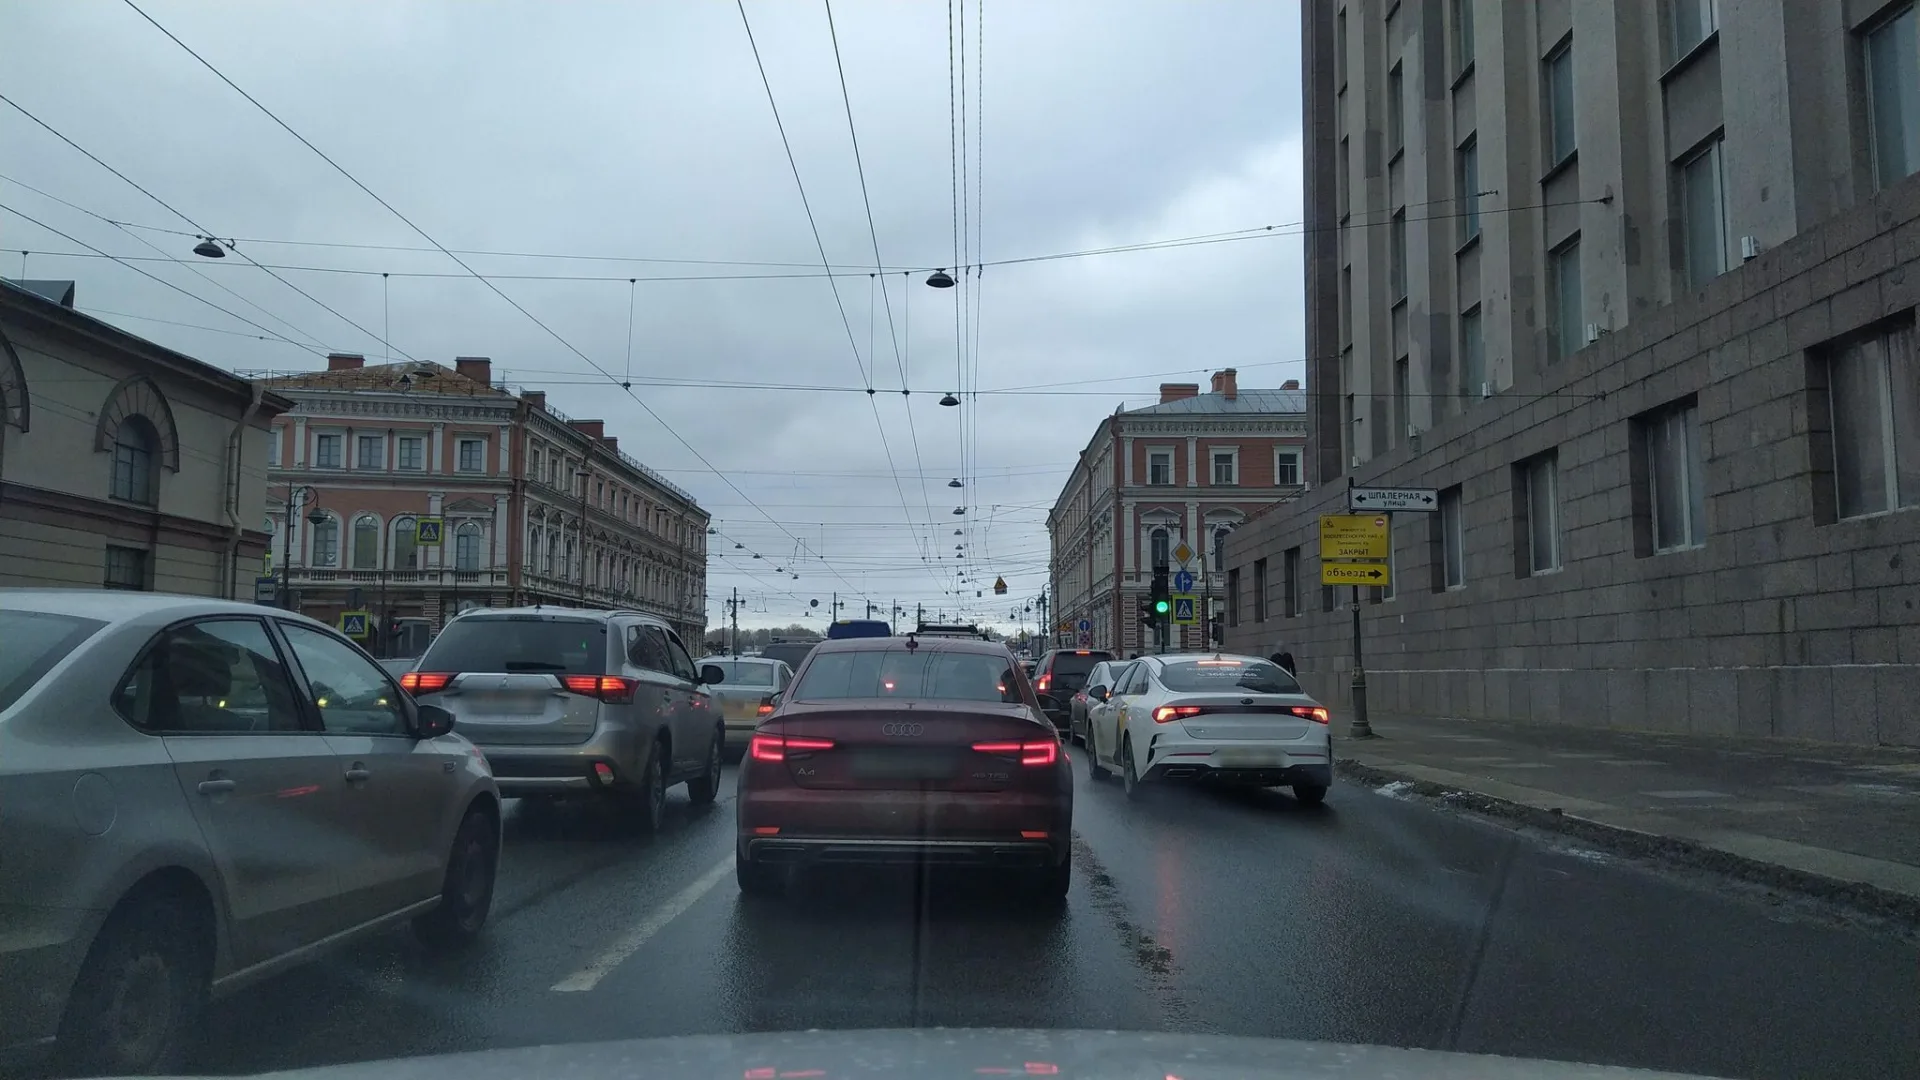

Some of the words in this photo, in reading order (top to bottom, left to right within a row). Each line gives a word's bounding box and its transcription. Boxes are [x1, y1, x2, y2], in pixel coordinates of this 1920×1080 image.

[1368, 491, 1421, 500] ШПАЛЕРНАЯ
[1383, 500, 1406, 508] улица
[1338, 548, 1369, 556] ЗАКРЫТ
[1326, 567, 1366, 578] объезд
[797, 767, 815, 776] A4
